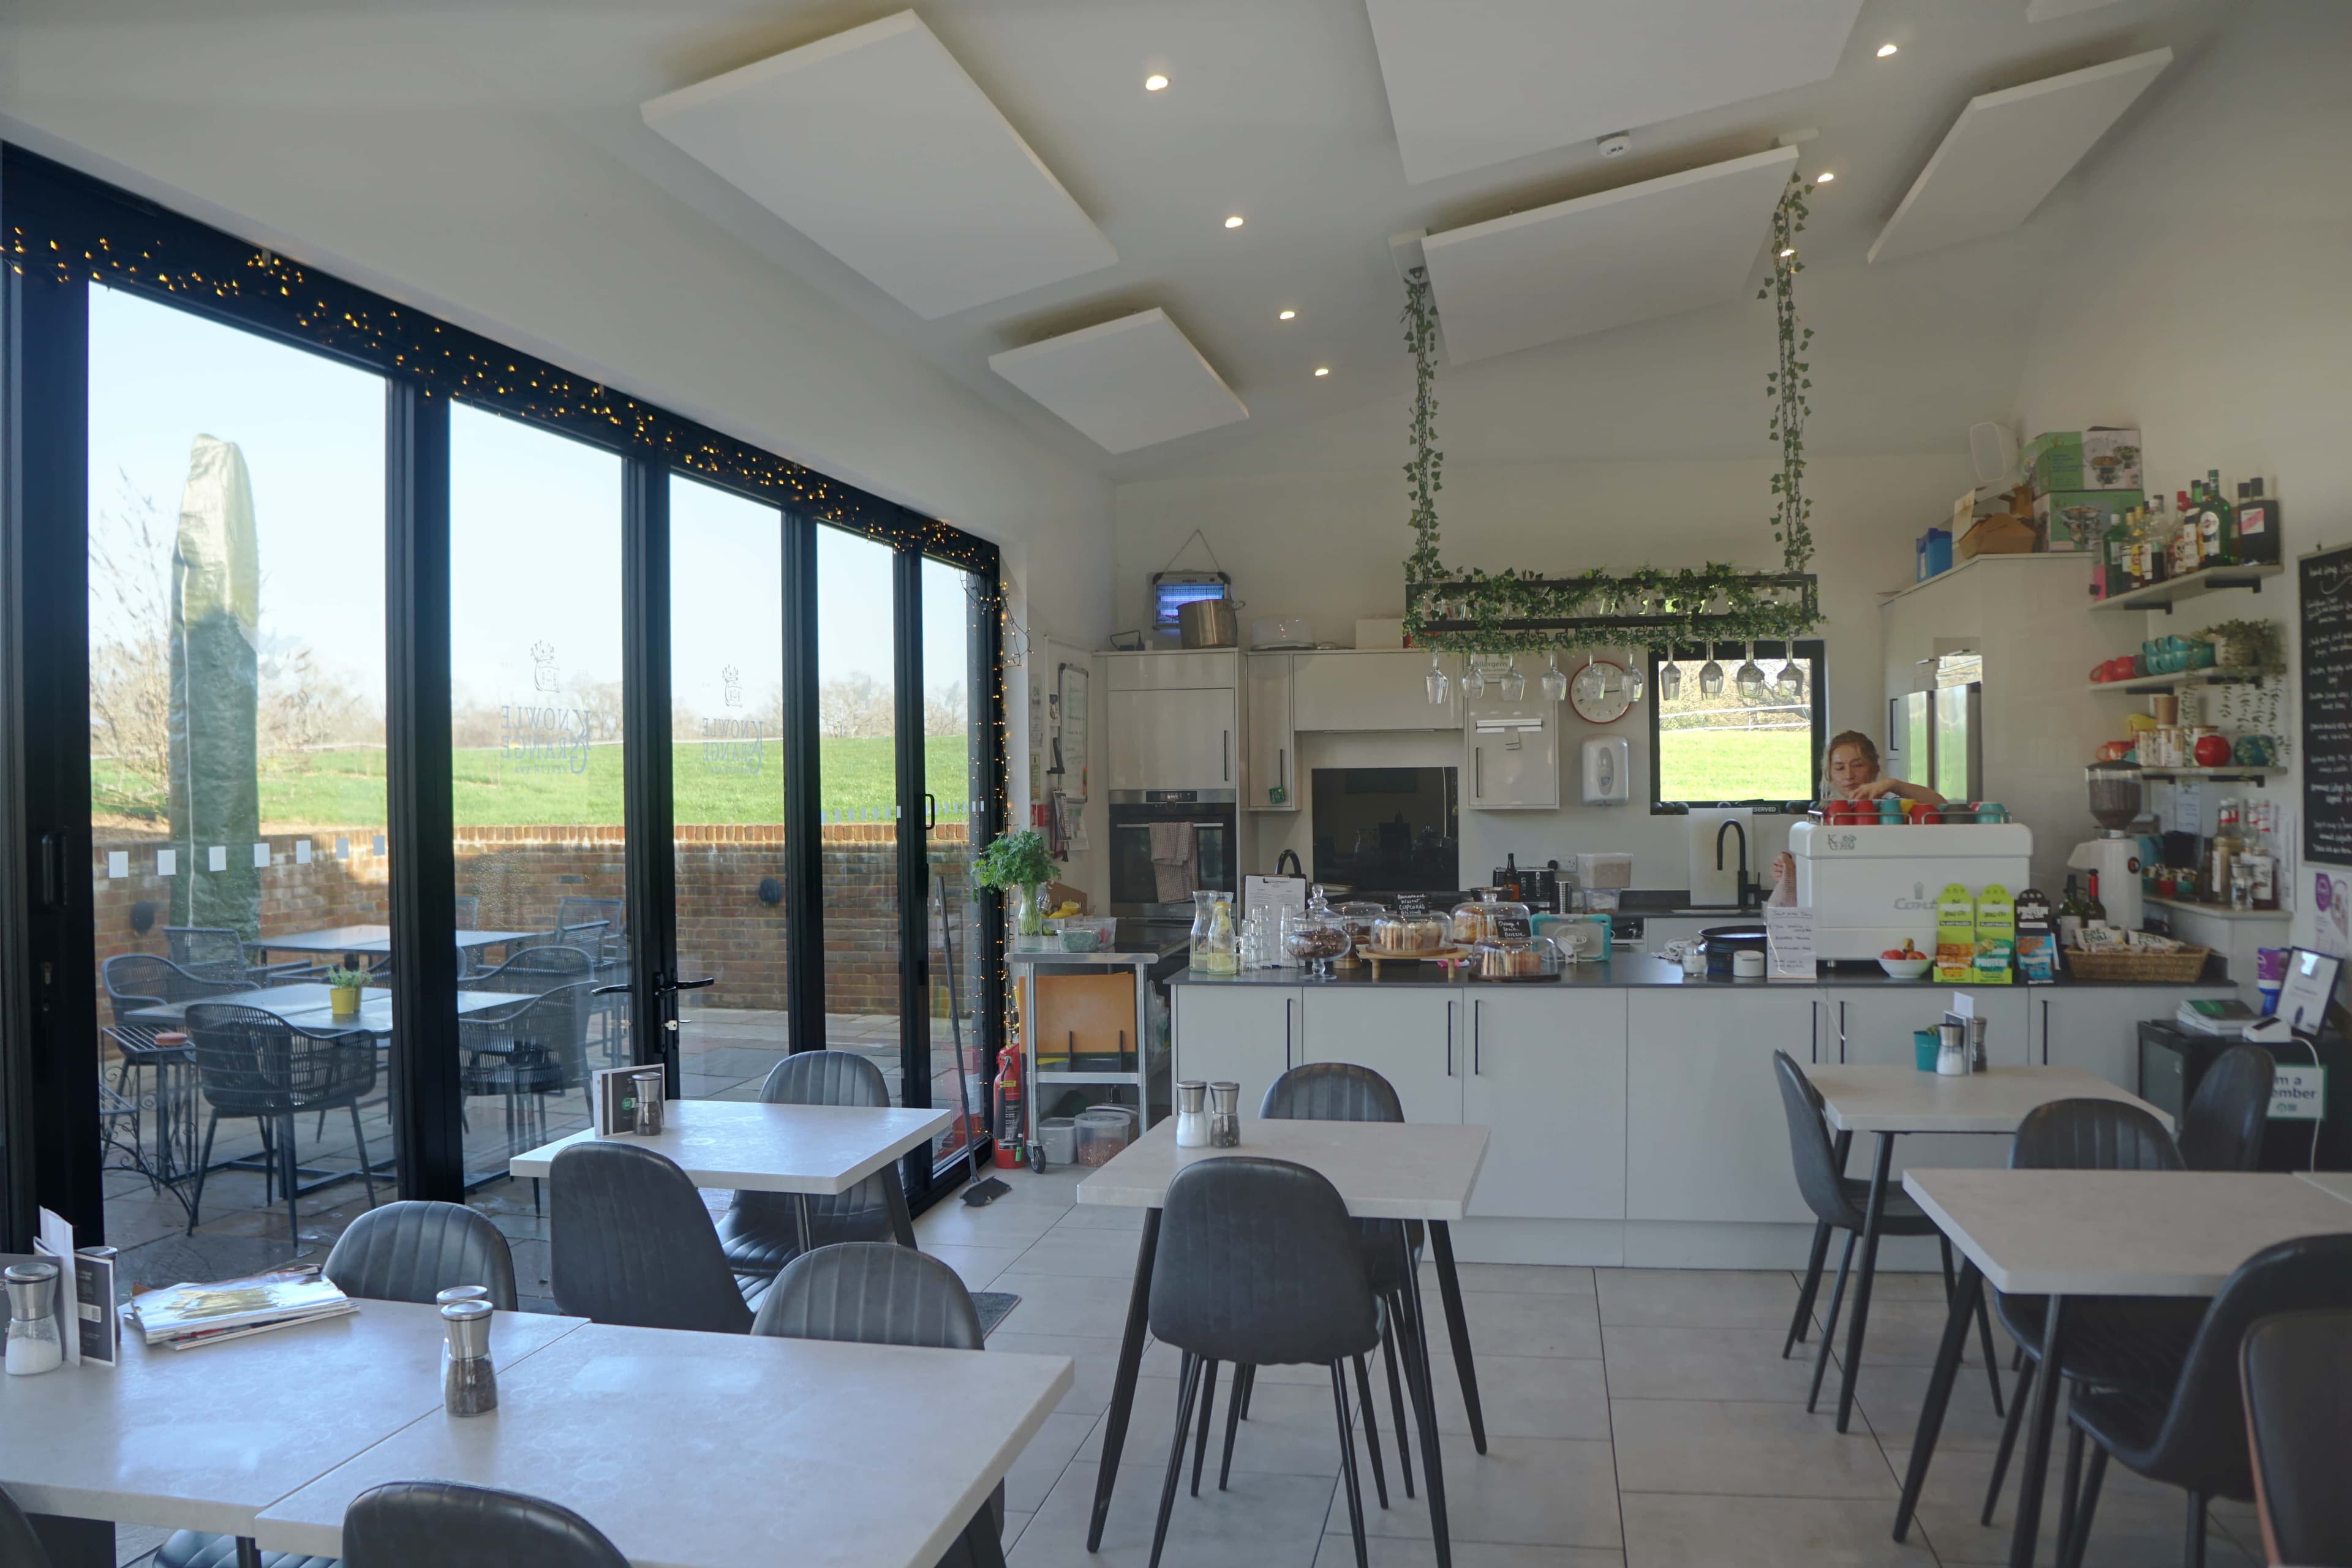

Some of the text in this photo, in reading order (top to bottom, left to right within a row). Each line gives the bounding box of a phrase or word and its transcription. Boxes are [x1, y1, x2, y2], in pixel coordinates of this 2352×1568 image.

[1893, 897, 1937, 911] Cont
[2273, 1076, 2302, 1085] m a
[2272, 1087, 2316, 1099] ember
